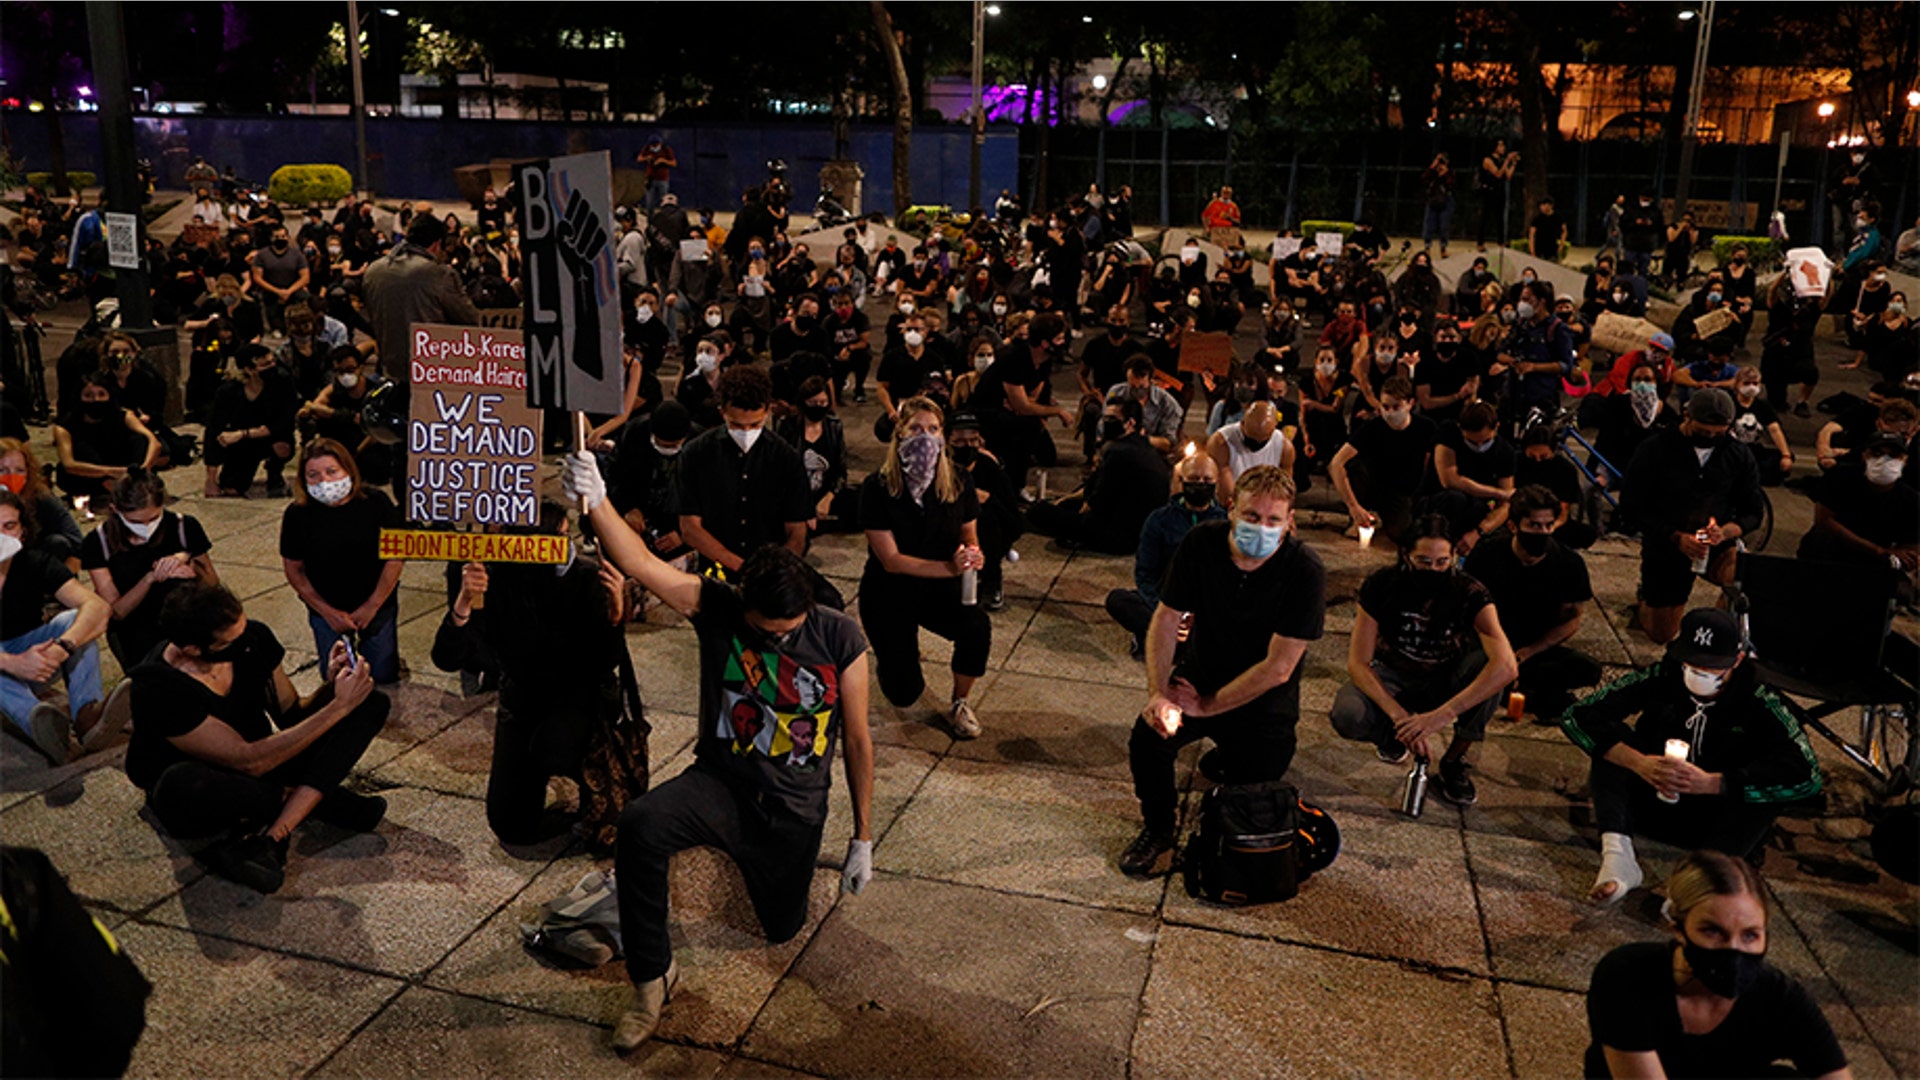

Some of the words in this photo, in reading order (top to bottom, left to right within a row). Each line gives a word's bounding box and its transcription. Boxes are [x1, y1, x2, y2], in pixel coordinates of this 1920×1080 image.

[521, 166, 563, 408] BLM
[410, 359, 484, 385] Demand
[433, 390, 504, 425] WE
[410, 421, 536, 457] DEMAND
[410, 459, 536, 494] JUSTICE
[410, 490, 536, 526] REFORM
[1693, 625, 1714, 647] NY
